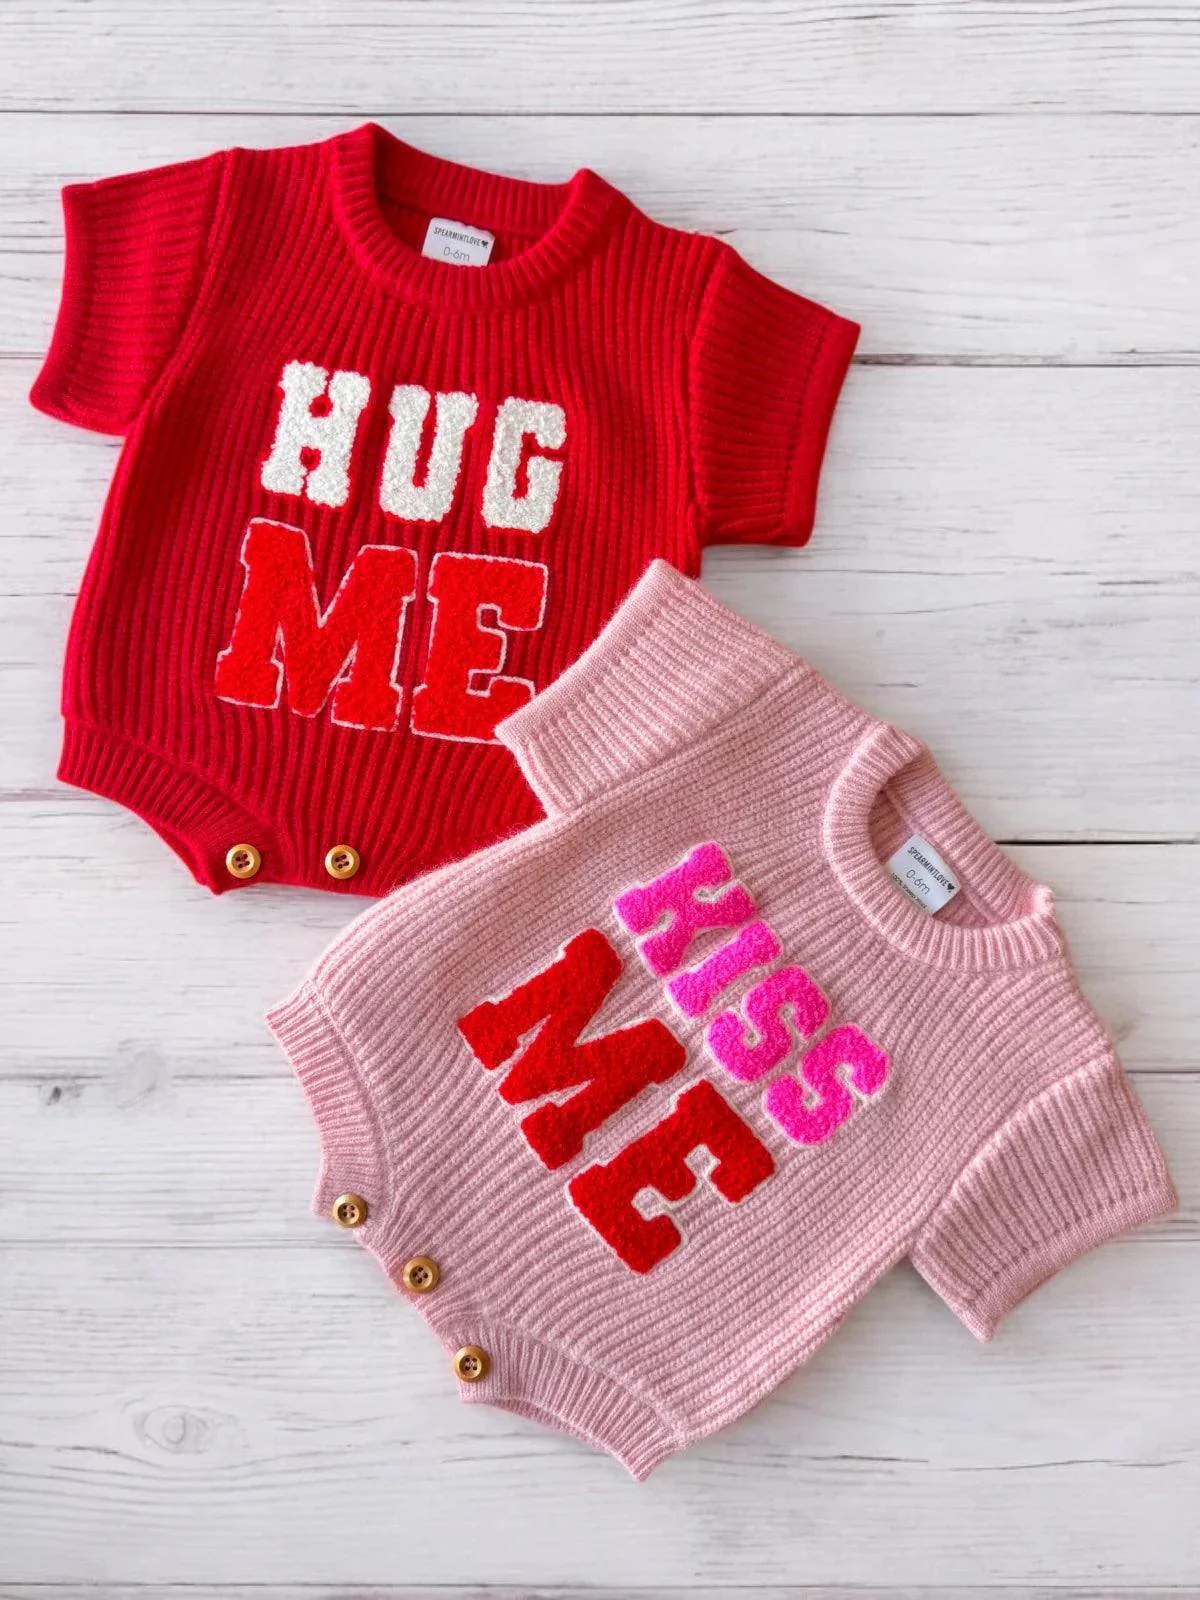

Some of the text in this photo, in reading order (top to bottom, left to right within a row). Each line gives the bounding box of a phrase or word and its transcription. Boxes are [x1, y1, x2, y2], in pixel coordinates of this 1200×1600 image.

[433, 227, 480, 247] SPEARMINTLOVE
[443, 246, 470, 262] 0-6m
[261, 360, 567, 534] HUG
[215, 517, 548, 745] ME
[906, 869, 930, 895] 0-6m
[907, 846, 949, 887] SPEARMINTLOVE
[613, 840, 892, 1148] KISS
[456, 927, 777, 1275] ME
